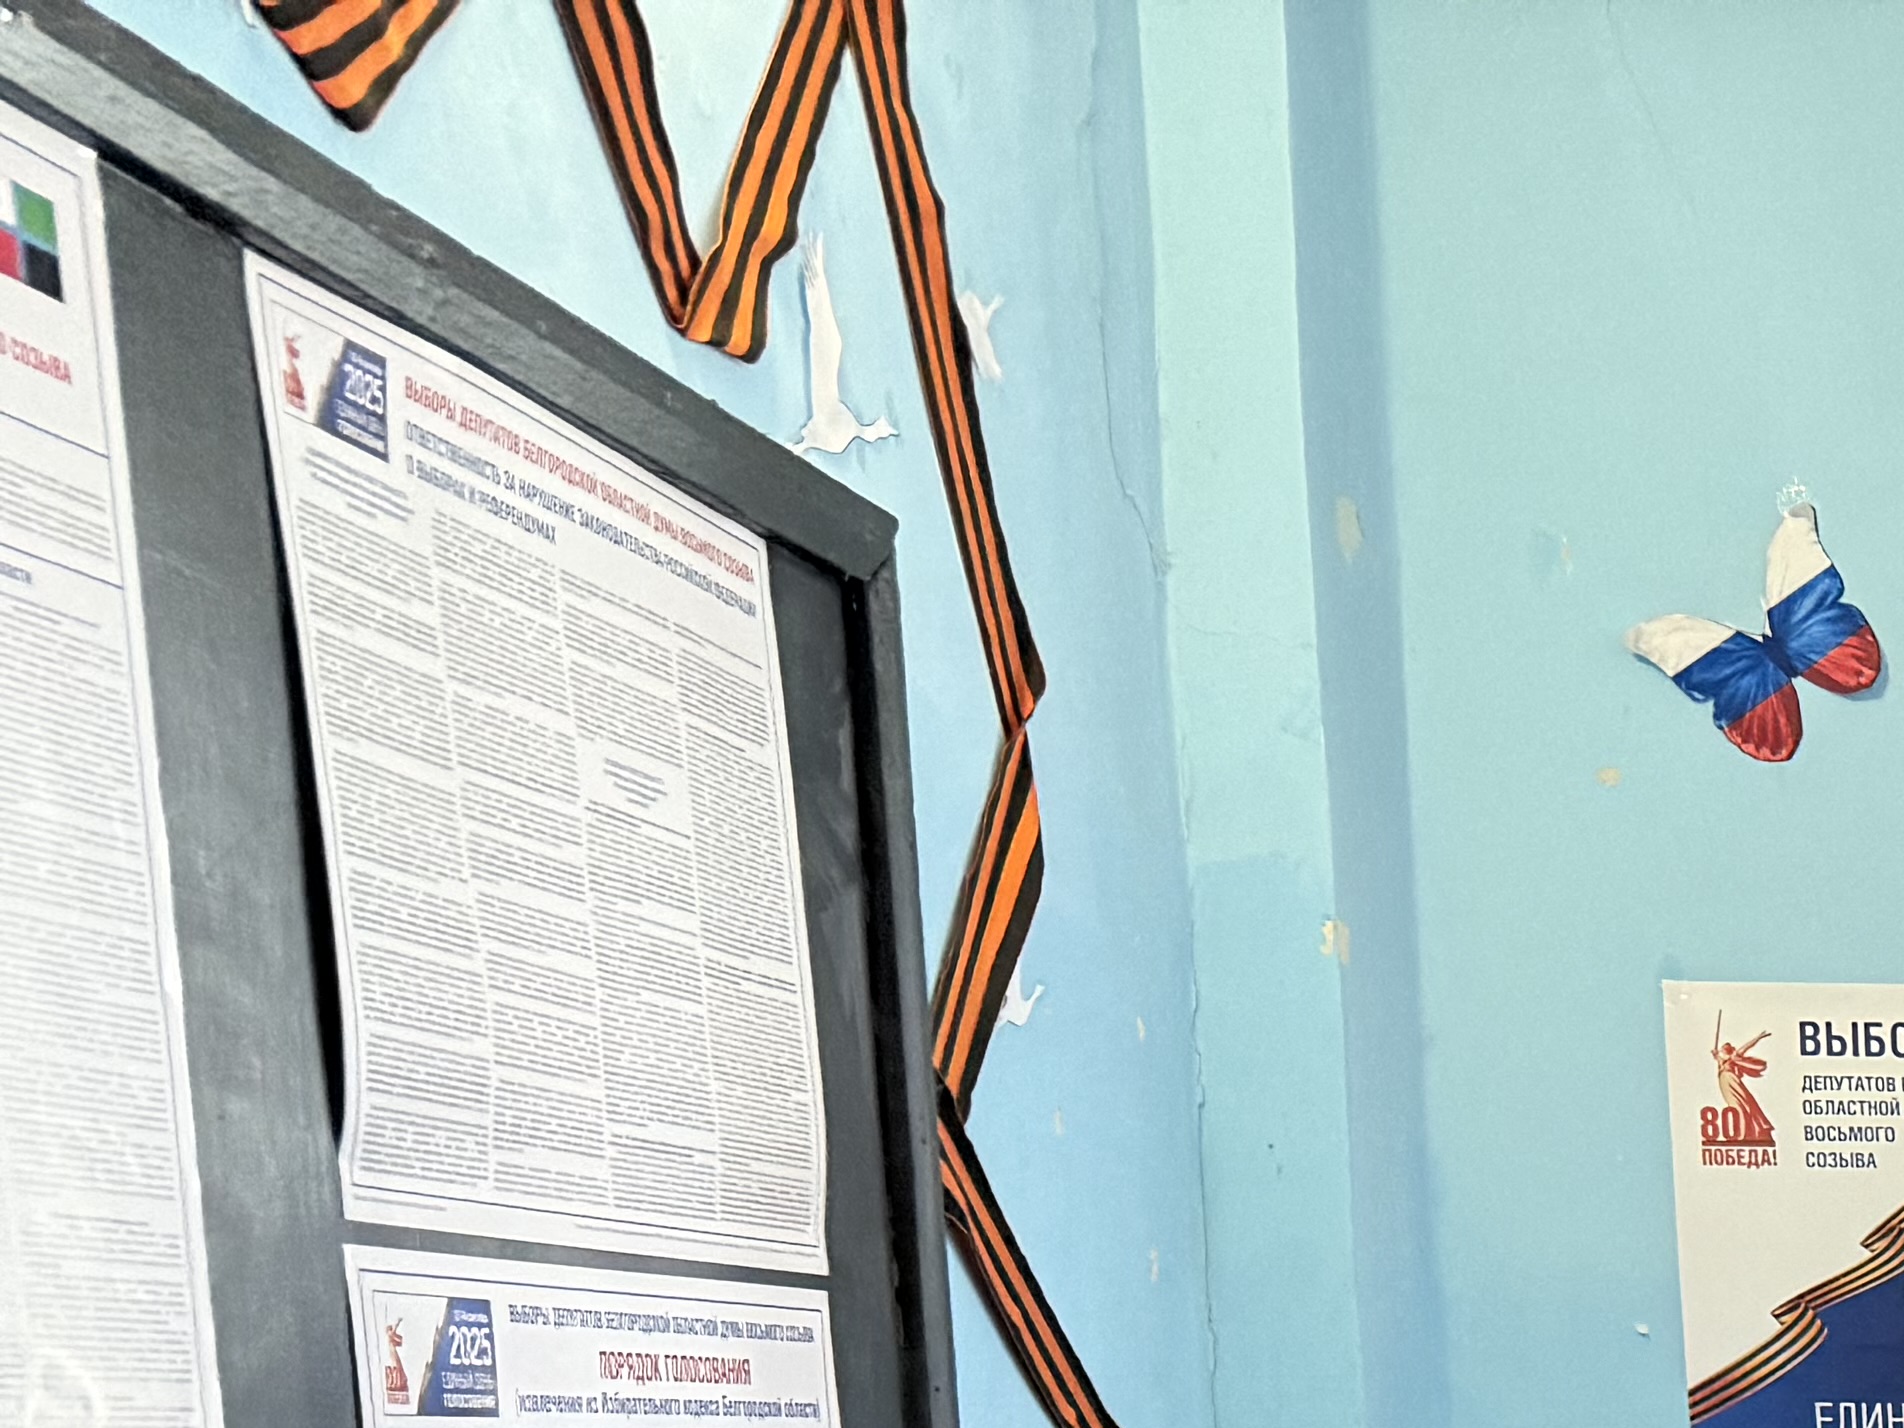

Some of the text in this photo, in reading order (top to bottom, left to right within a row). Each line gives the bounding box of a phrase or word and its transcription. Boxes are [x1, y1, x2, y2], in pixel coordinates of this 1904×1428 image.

[405, 375, 456, 422] ВЫБОРЫ
[503, 470, 516, 495] ЗА
[1802, 1075, 1896, 1094] ДЕПУТАТОВ
[1802, 1098, 1900, 1117] ОБЛАСТНОЙ
[1700, 1106, 1741, 1141] 80
[1804, 1125, 1896, 1143] ВОСЬМОГО
[1701, 1148, 1779, 1169] ПОБЕДА!
[1806, 1152, 1877, 1169] СОЗЫВА
[448, 1325, 493, 1366] 2025
[599, 1351, 752, 1386] ПОРЯДОК ГОЛОСОВАНИЯ
